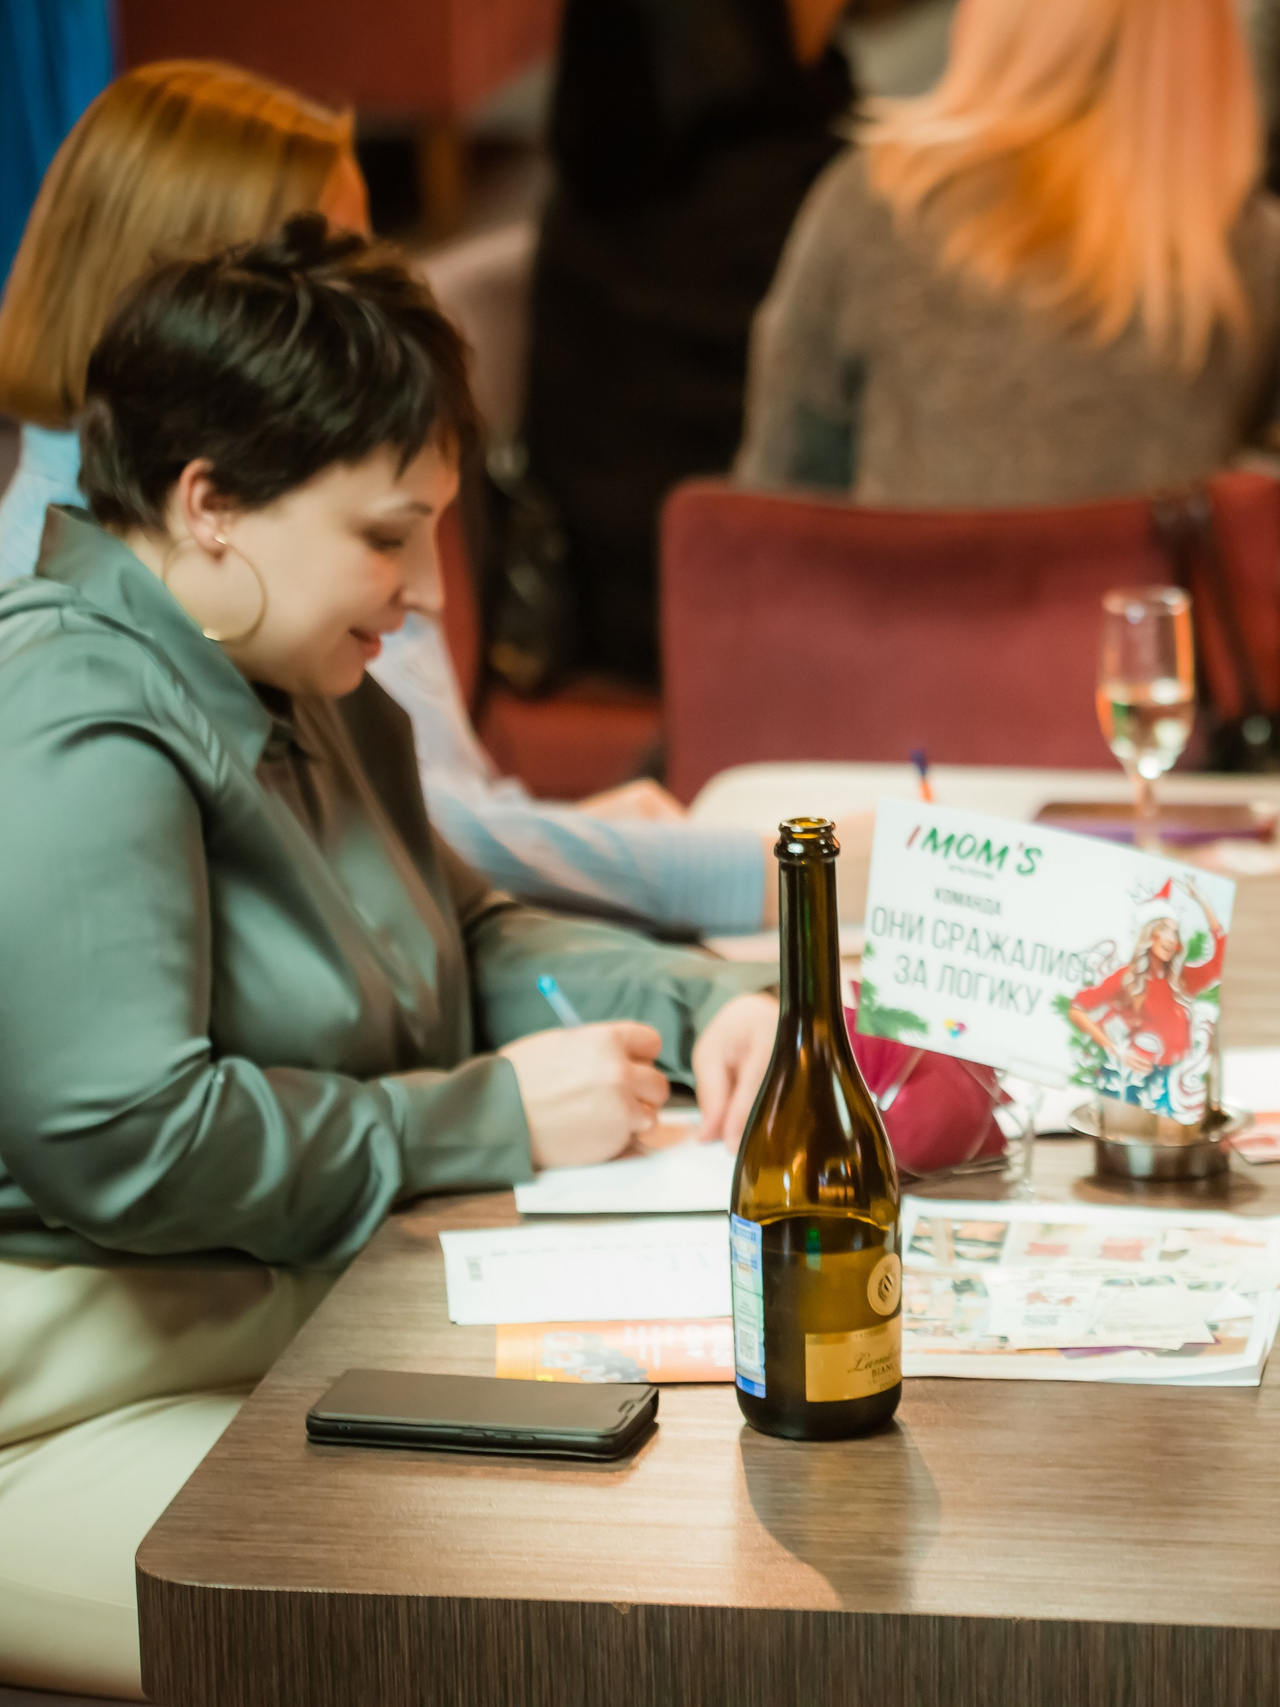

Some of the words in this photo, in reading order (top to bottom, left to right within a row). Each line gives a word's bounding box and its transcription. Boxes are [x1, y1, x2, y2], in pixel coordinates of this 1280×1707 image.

[934, 887, 1003, 917] КОМАНДА
[871, 906, 925, 945] ОНИ
[931, 918, 1096, 987] СРАЖАЛИСЬ
[893, 954, 928, 990] ЗА
[936, 964, 1042, 1016] ЛОГИКУ
